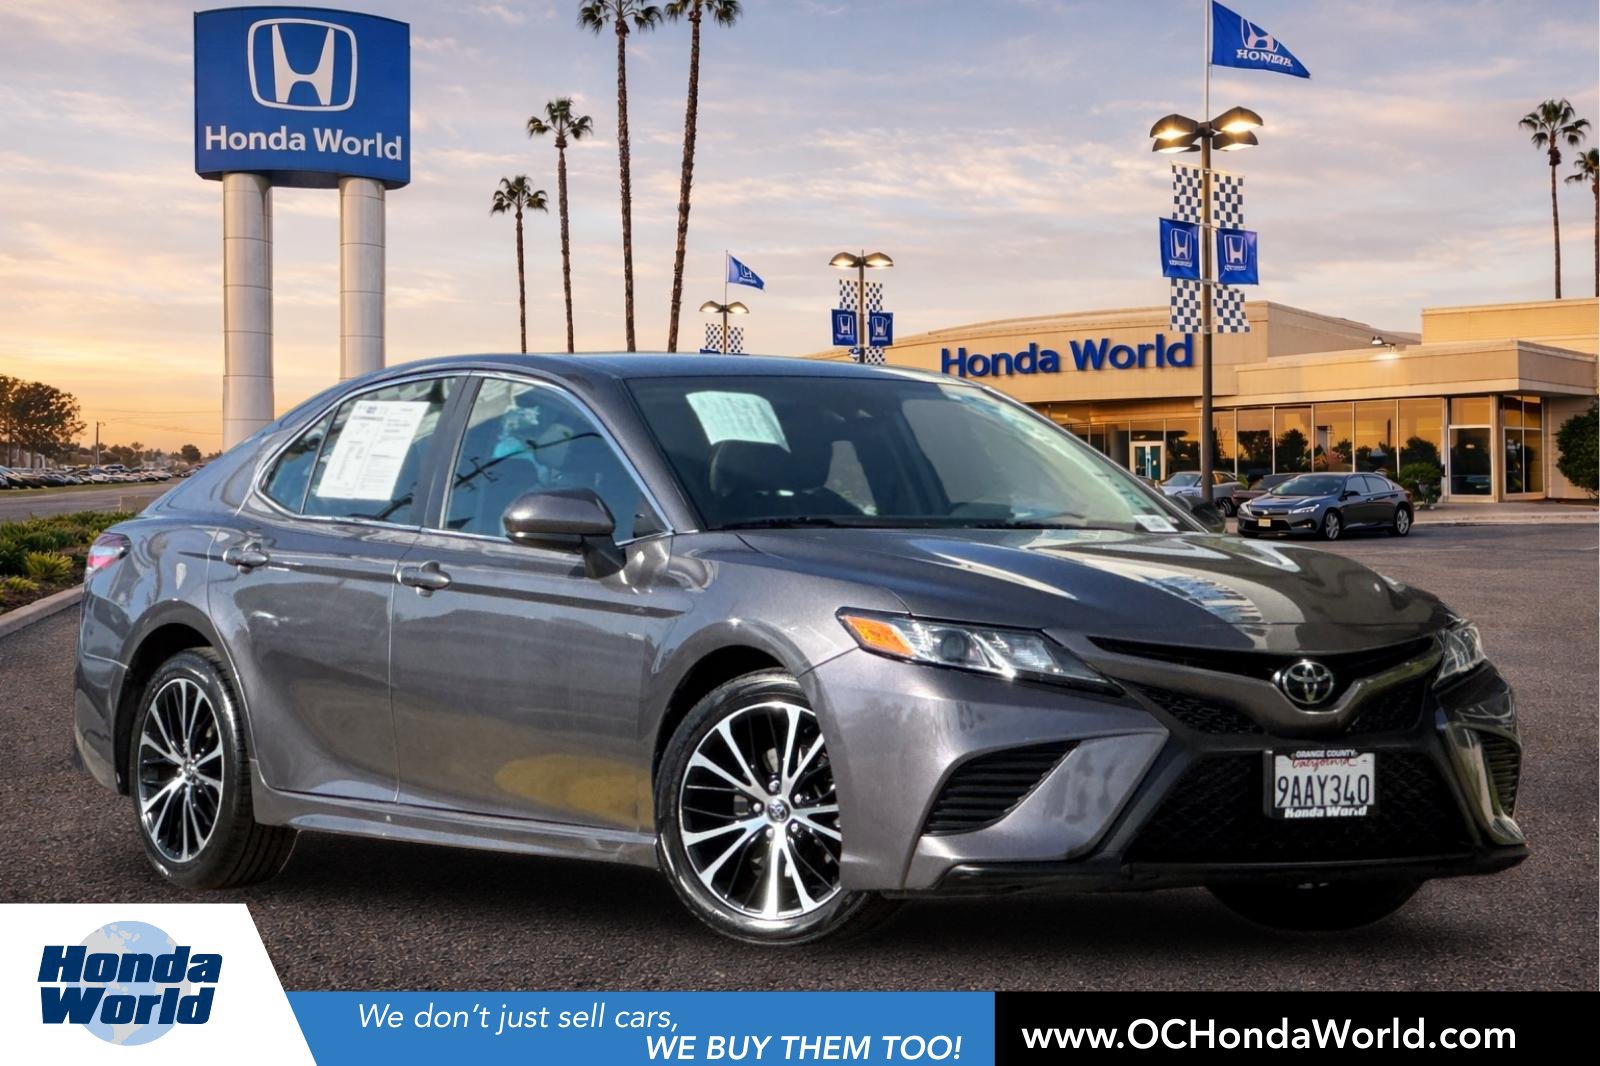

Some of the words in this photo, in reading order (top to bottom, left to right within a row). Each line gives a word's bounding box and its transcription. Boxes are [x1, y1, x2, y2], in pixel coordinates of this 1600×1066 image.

[205, 125, 306, 151] Honda
[313, 127, 402, 160] World
[941, 342, 1061, 378] Honda
[1069, 333, 1193, 371] World
[1295, 750, 1325, 758] ORANGE
[1326, 749, 1356, 757] COUNTY
[1277, 774, 1369, 807] 9AAY340
